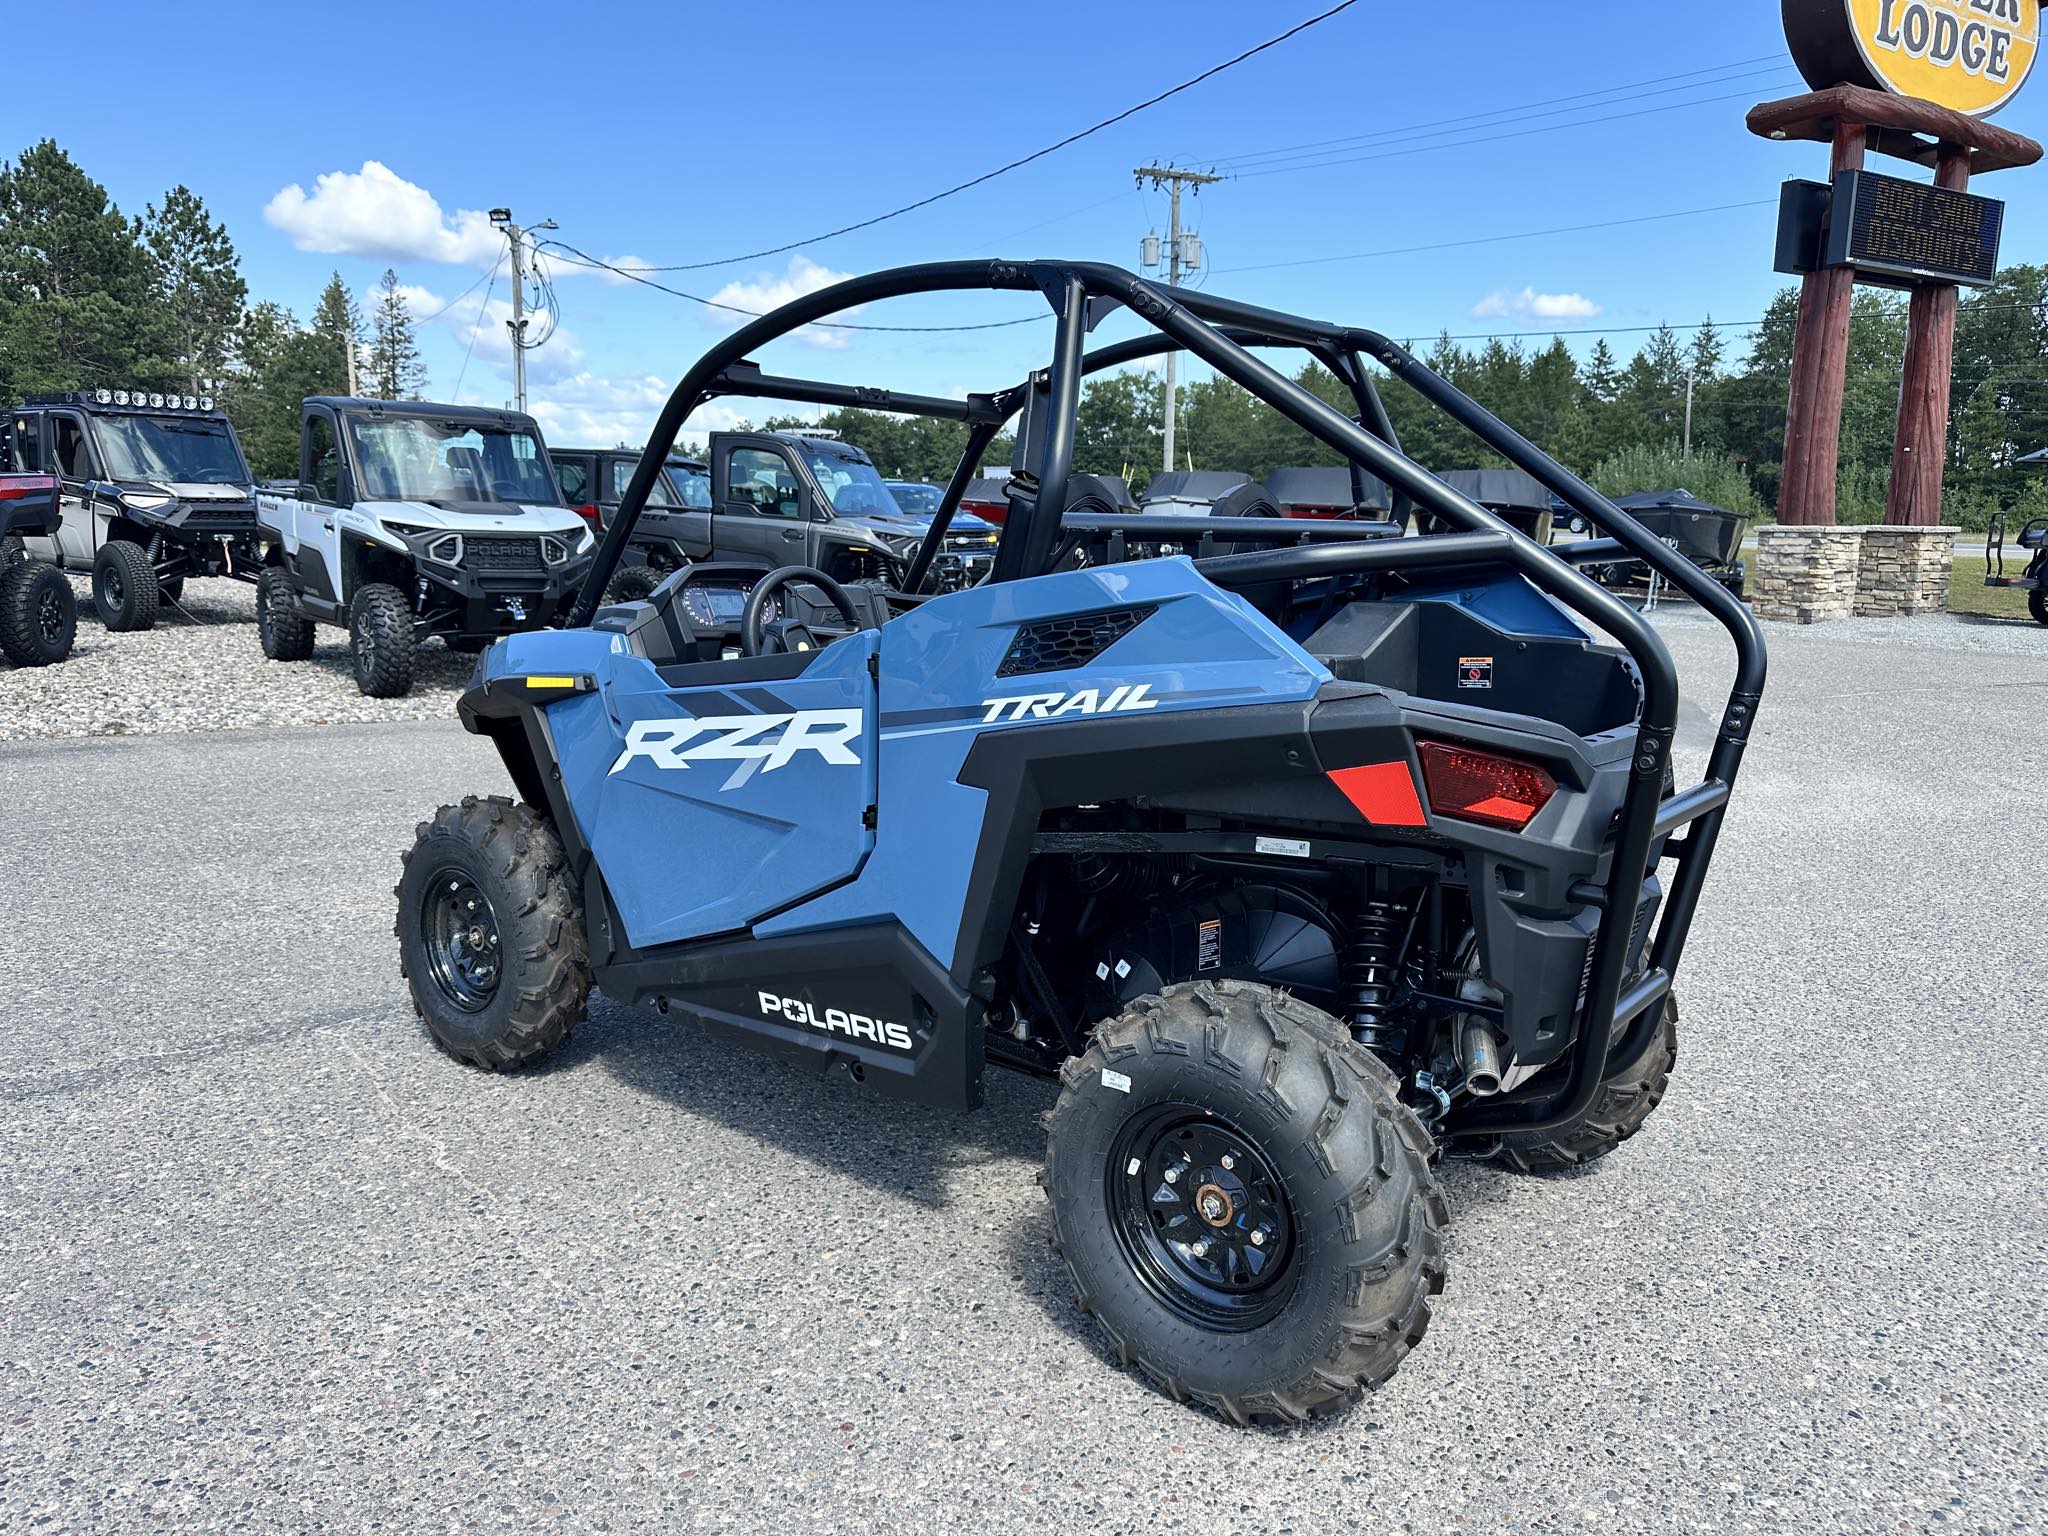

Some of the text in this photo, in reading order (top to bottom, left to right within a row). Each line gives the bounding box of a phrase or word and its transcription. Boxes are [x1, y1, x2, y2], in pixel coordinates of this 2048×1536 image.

[1876, 0, 2011, 80] LODGE
[1874, 180, 1928, 224] BOAT
[466, 544, 537, 556] POLARIS
[981, 683, 1159, 723] TRAIL
[607, 708, 863, 777] RZR
[757, 990, 913, 1050] POLARIS
